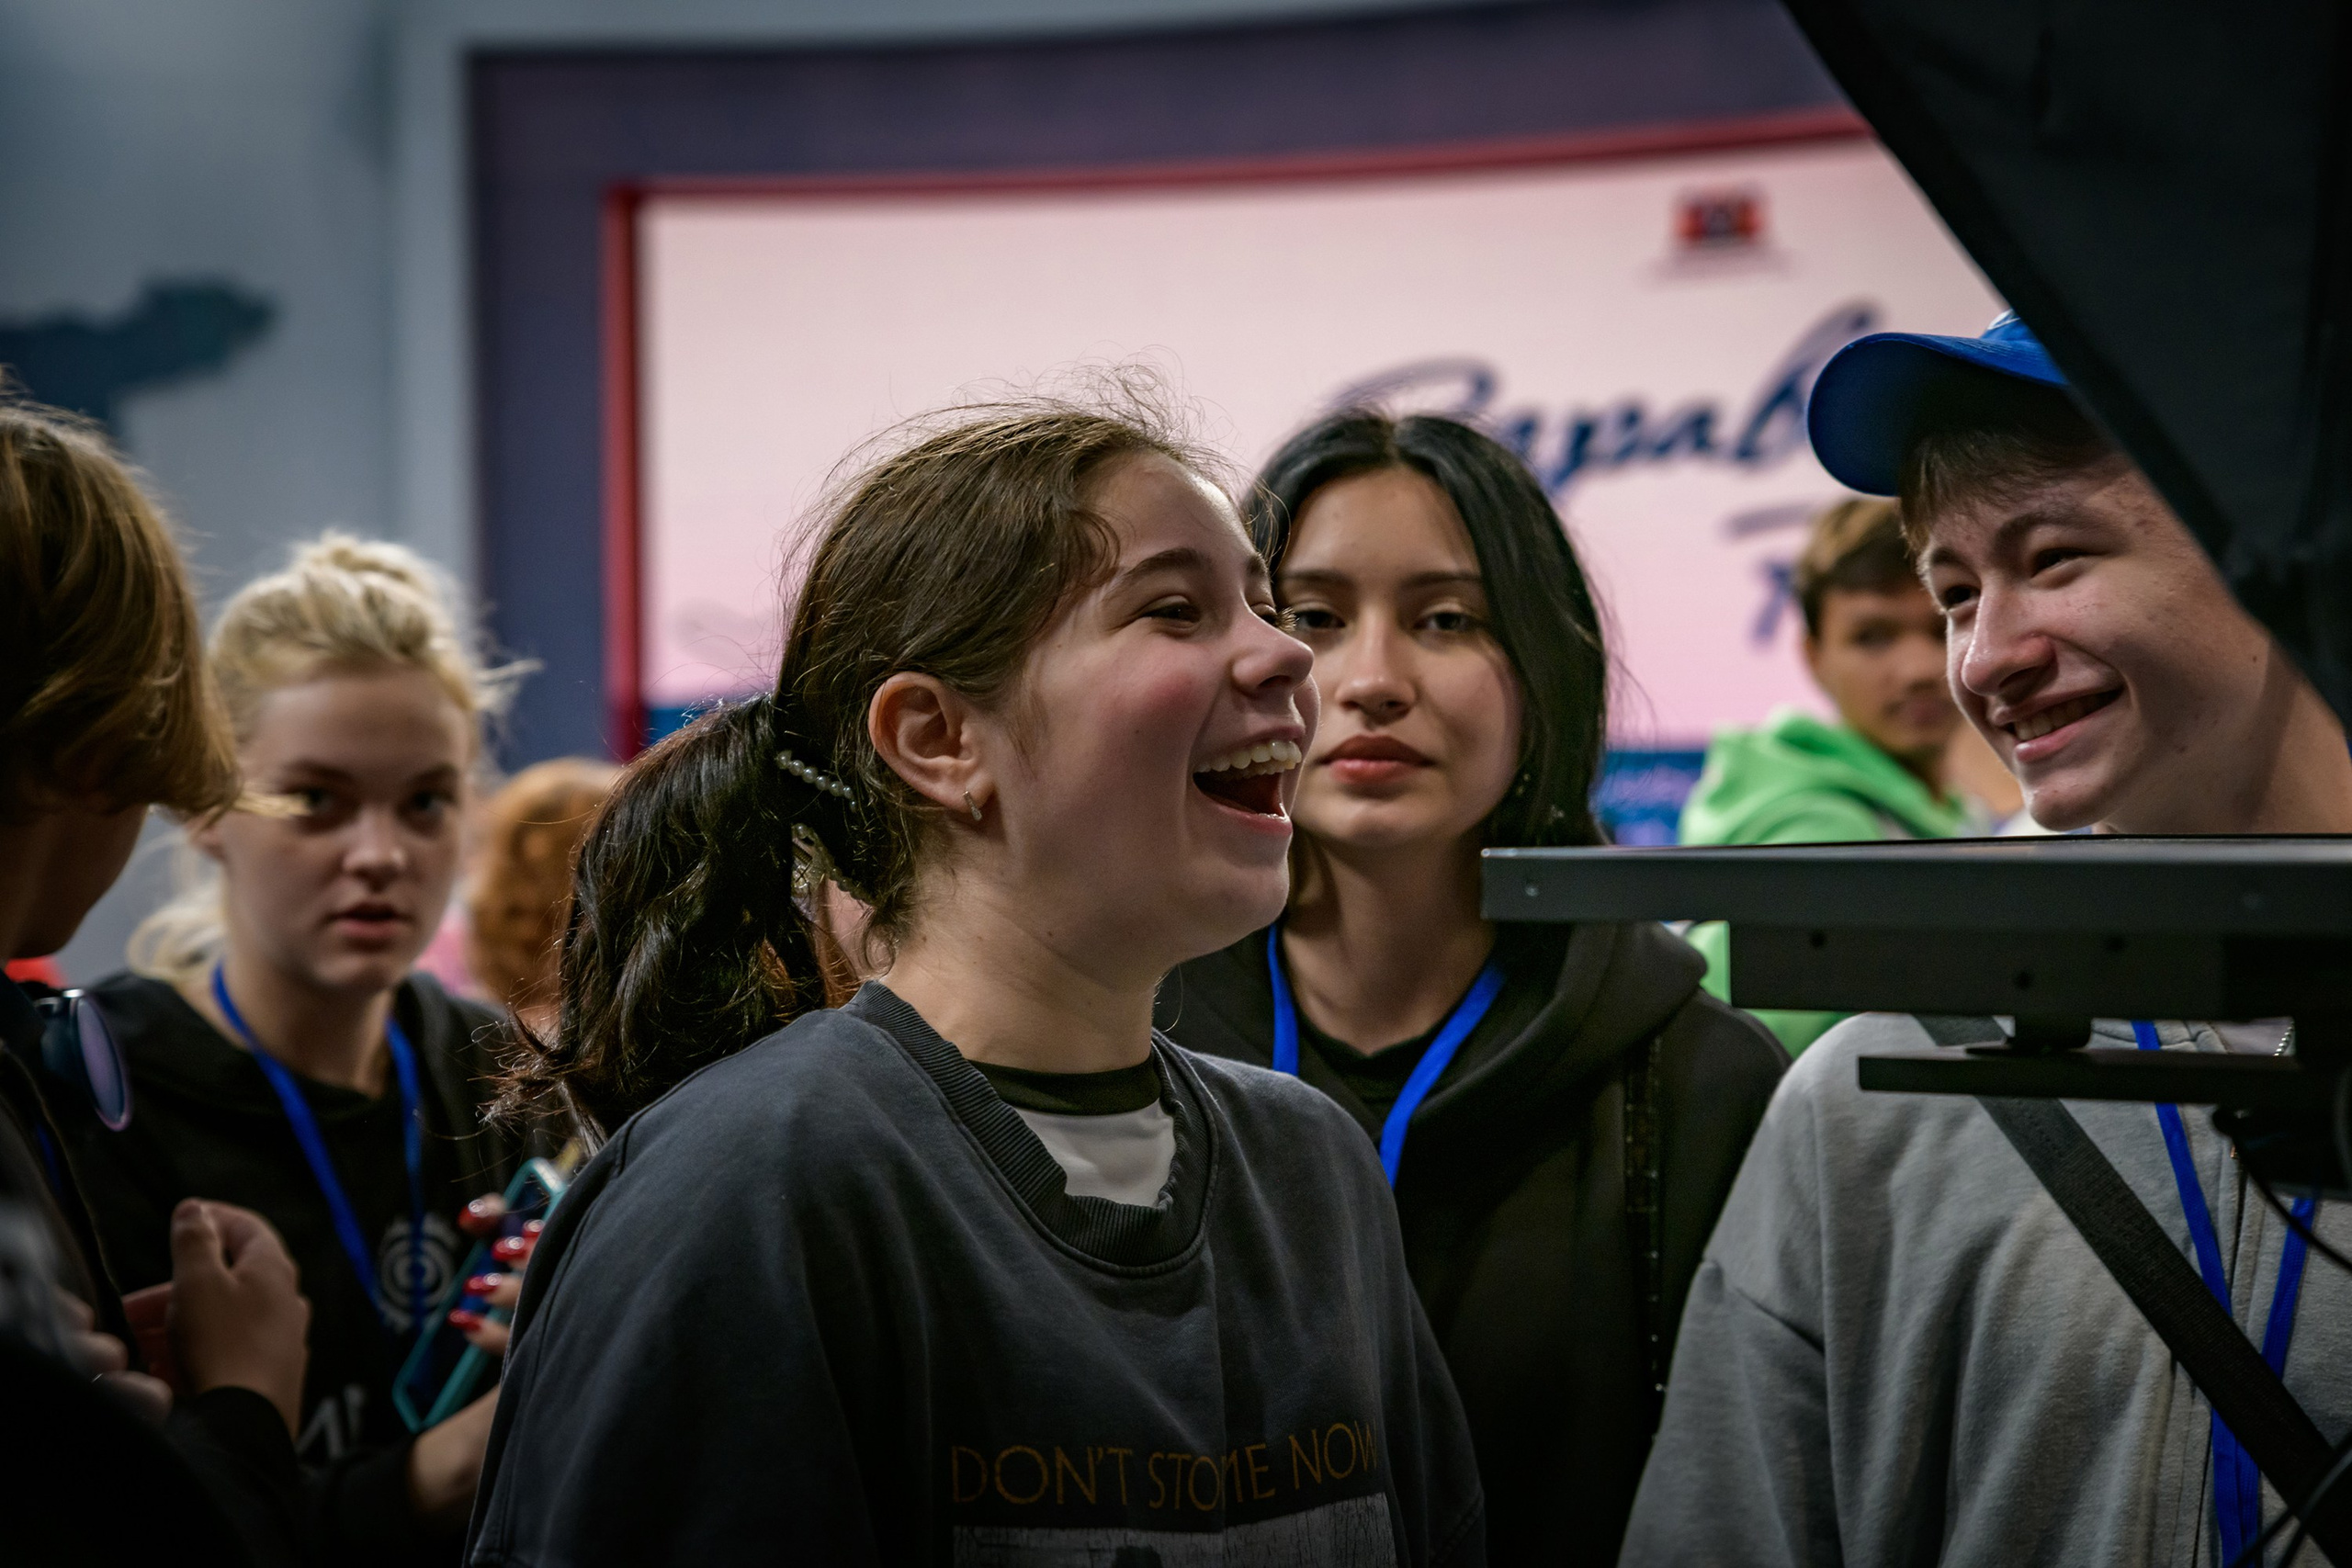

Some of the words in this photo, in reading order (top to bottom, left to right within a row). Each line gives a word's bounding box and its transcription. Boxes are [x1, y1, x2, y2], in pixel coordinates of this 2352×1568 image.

[951, 1444, 1133, 1506] DON'T
[1148, 1450, 1227, 1512] STO
[1288, 1416, 1377, 1491] NOW
